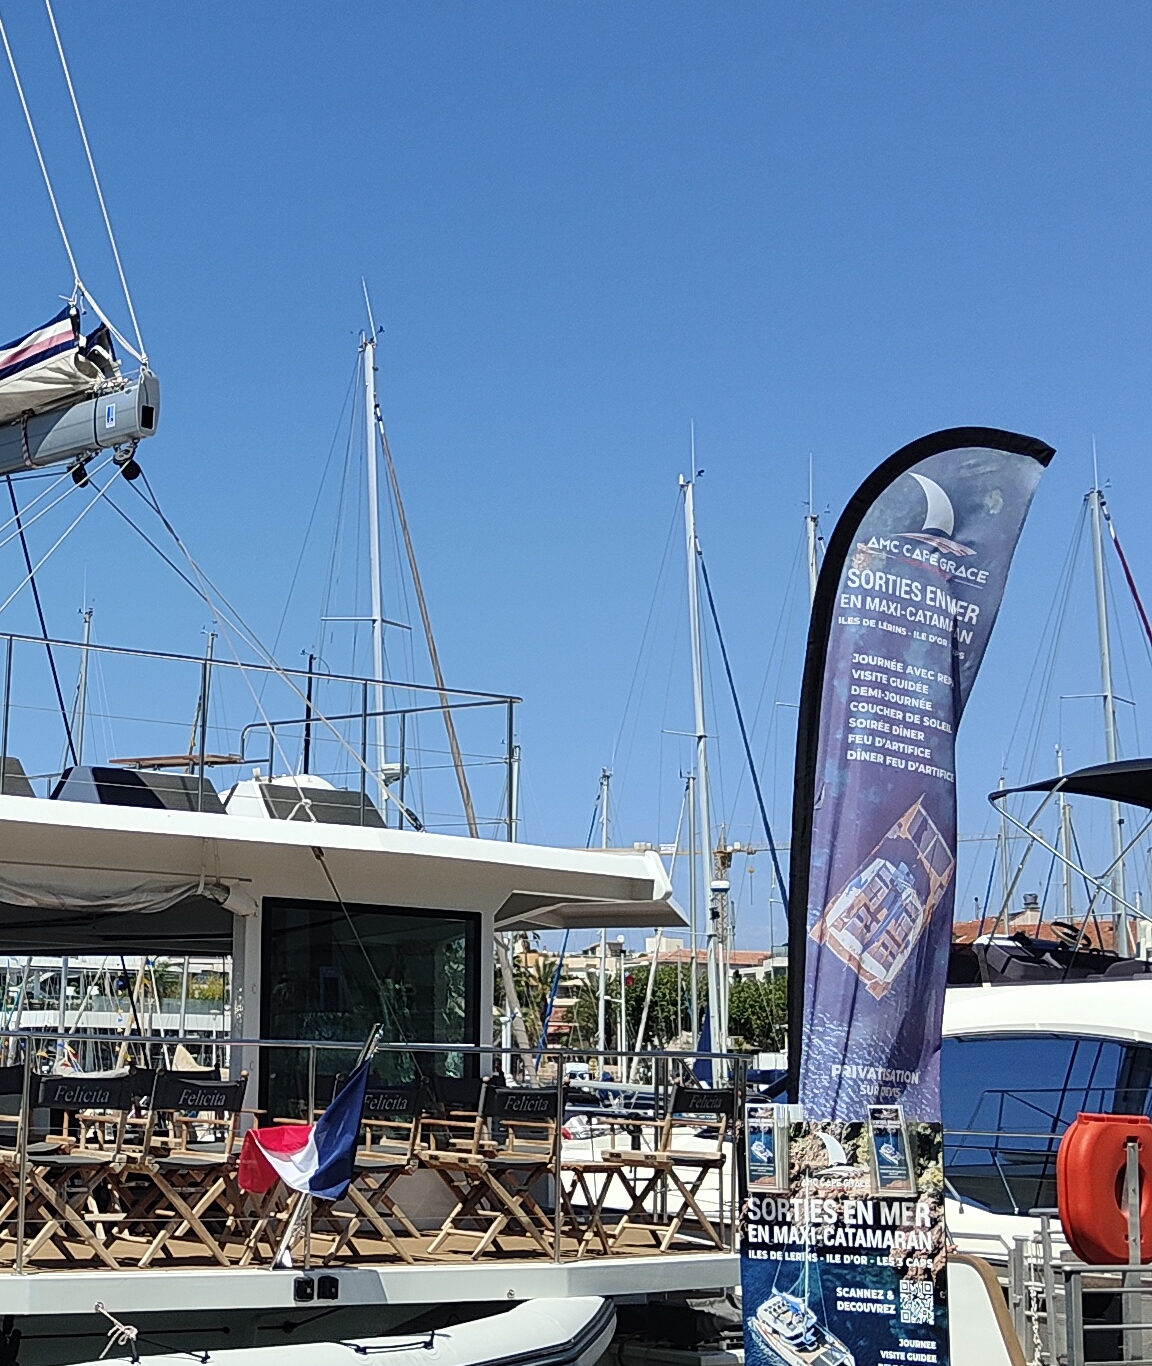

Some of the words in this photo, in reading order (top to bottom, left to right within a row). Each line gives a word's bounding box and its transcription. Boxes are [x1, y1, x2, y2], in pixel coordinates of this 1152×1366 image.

[867, 536, 899, 553] AMC
[939, 559, 990, 584] GRACE
[847, 568, 922, 602] SORTIES
[926, 585, 946, 610] EN
[840, 593, 862, 609] EN
[838, 616, 861, 626] ILES
[862, 618, 876, 628] DE
[913, 630, 927, 640] ILE
[929, 632, 948, 647] D'OR
[851, 653, 904, 672] JOURNÉE
[906, 665, 935, 680] AVEC
[851, 669, 888, 684] VISITE
[890, 677, 929, 694] GUIDÉE
[851, 685, 933, 711] DEMI-JOURNÉE
[850, 701, 903, 720] COUCHER
[906, 712, 921, 724] DE
[923, 716, 953, 734] SOLEIL
[848, 717, 890, 733] SOIRÉE
[892, 724, 925, 741] DÎNER
[848, 734, 872, 744] FEU
[875, 736, 931, 759] D'ARTIFICE
[846, 748, 884, 764] DÎNER
[886, 756, 905, 769] FEU
[908, 761, 955, 783] D'ARTIFICE
[831, 1064, 920, 1084] PRIVATISATION
[54, 1085, 110, 1103] Felicita
[179, 1089, 226, 1106] Felicita
[860, 1084, 879, 1096] SUR
[364, 1094, 408, 1110] Felicita
[504, 1095, 549, 1111] Felicita
[689, 1094, 723, 1109] Felicita
[747, 1197, 838, 1224] SORTIES
[843, 1199, 875, 1226] EN
[879, 1200, 931, 1227] MER
[748, 1224, 770, 1243] EN
[773, 1225, 933, 1251] MAXI-CATAMARAN
[748, 1249, 768, 1259] ILES
[769, 1250, 783, 1260] DE
[784, 1251, 818, 1263] LERINS
[826, 1253, 841, 1264] ILE
[843, 1254, 868, 1266] D'OR
[876, 1256, 895, 1267] LES
[905, 1257, 934, 1269] CAPS
[836, 1287, 885, 1300] SCANNEZ
[836, 1301, 896, 1314] DECOUVREZ
[898, 1338, 937, 1349] JOURNEE
[880, 1350, 905, 1360] VISITE
[907, 1352, 937, 1363] GUIDEE
